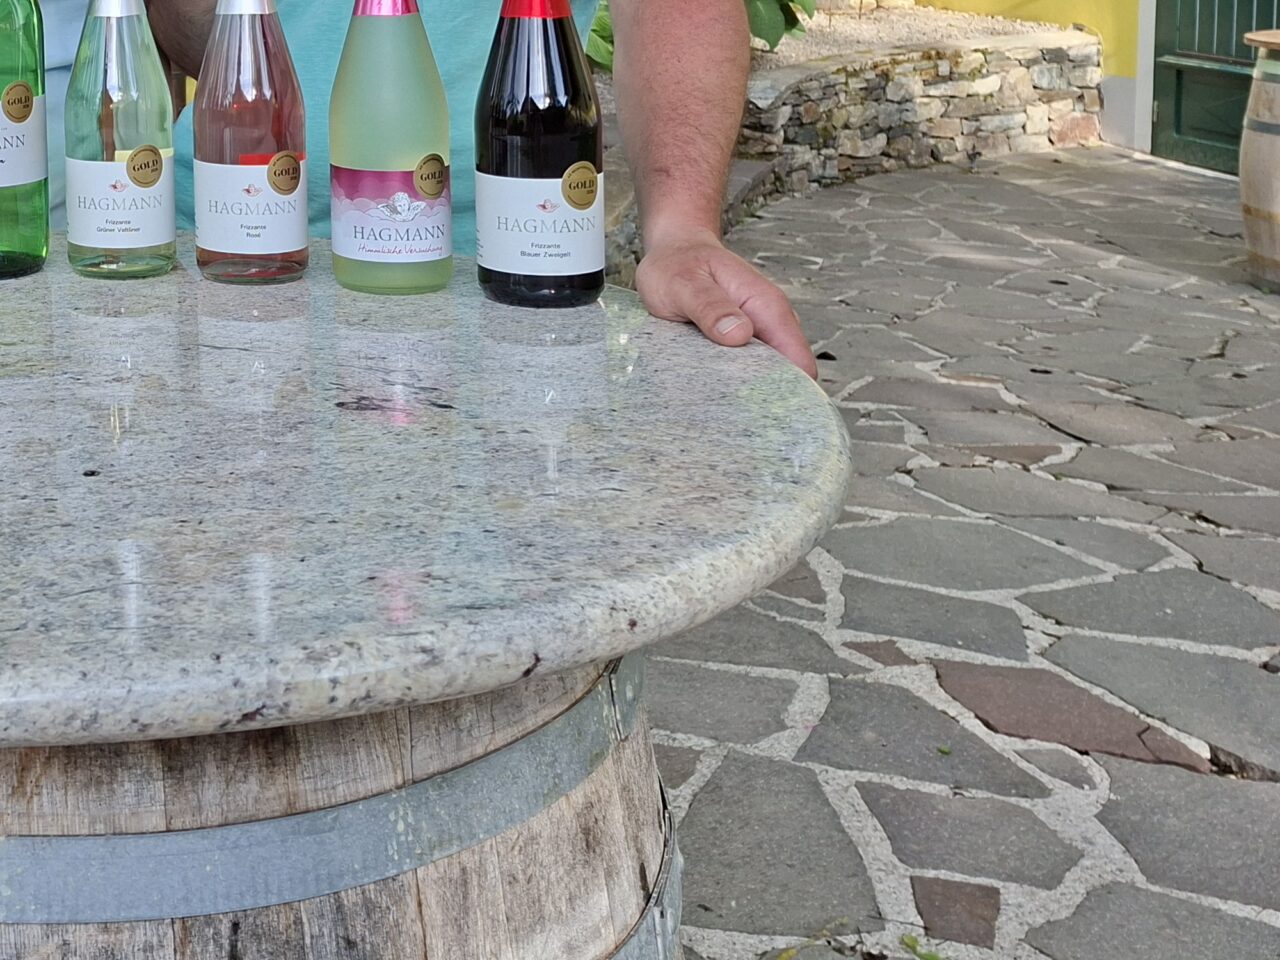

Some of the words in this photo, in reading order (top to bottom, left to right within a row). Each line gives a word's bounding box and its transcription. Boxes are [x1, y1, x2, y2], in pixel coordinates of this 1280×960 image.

[7, 95, 30, 107] GOLD
[132, 159, 159, 173] GOLD
[273, 167, 298, 178] GOLD
[420, 170, 444, 182] GOLD
[568, 179, 595, 191] GOLD
[78, 194, 163, 211] HAGMANN
[208, 200, 297, 216] HAGMANN
[496, 216, 596, 234] HAGMANN
[353, 224, 445, 242] HAGMANN
[520, 250, 541, 258] Blauer
